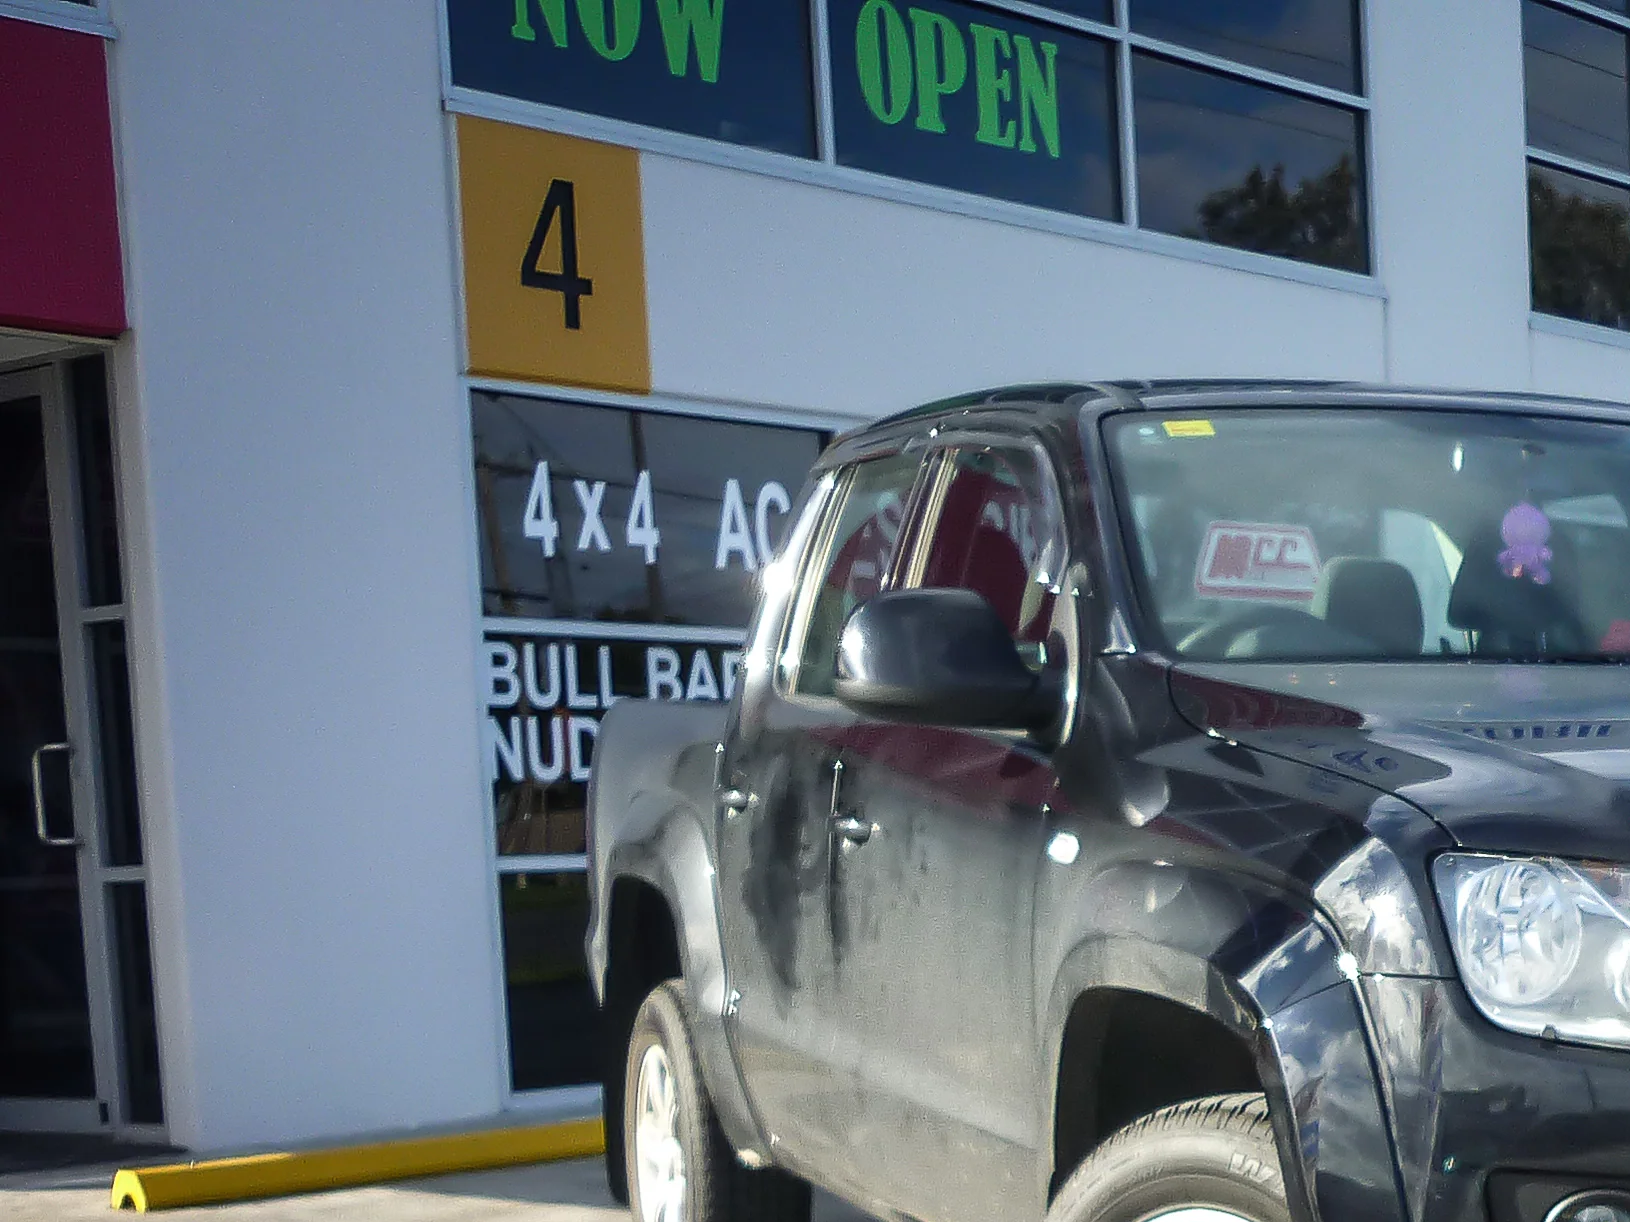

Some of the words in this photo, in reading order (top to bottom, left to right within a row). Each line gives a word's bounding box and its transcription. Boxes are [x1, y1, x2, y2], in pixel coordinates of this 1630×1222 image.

[856, 0, 1060, 158] OPEN
[520, 179, 593, 330] 4
[486, 641, 628, 710] BULL
